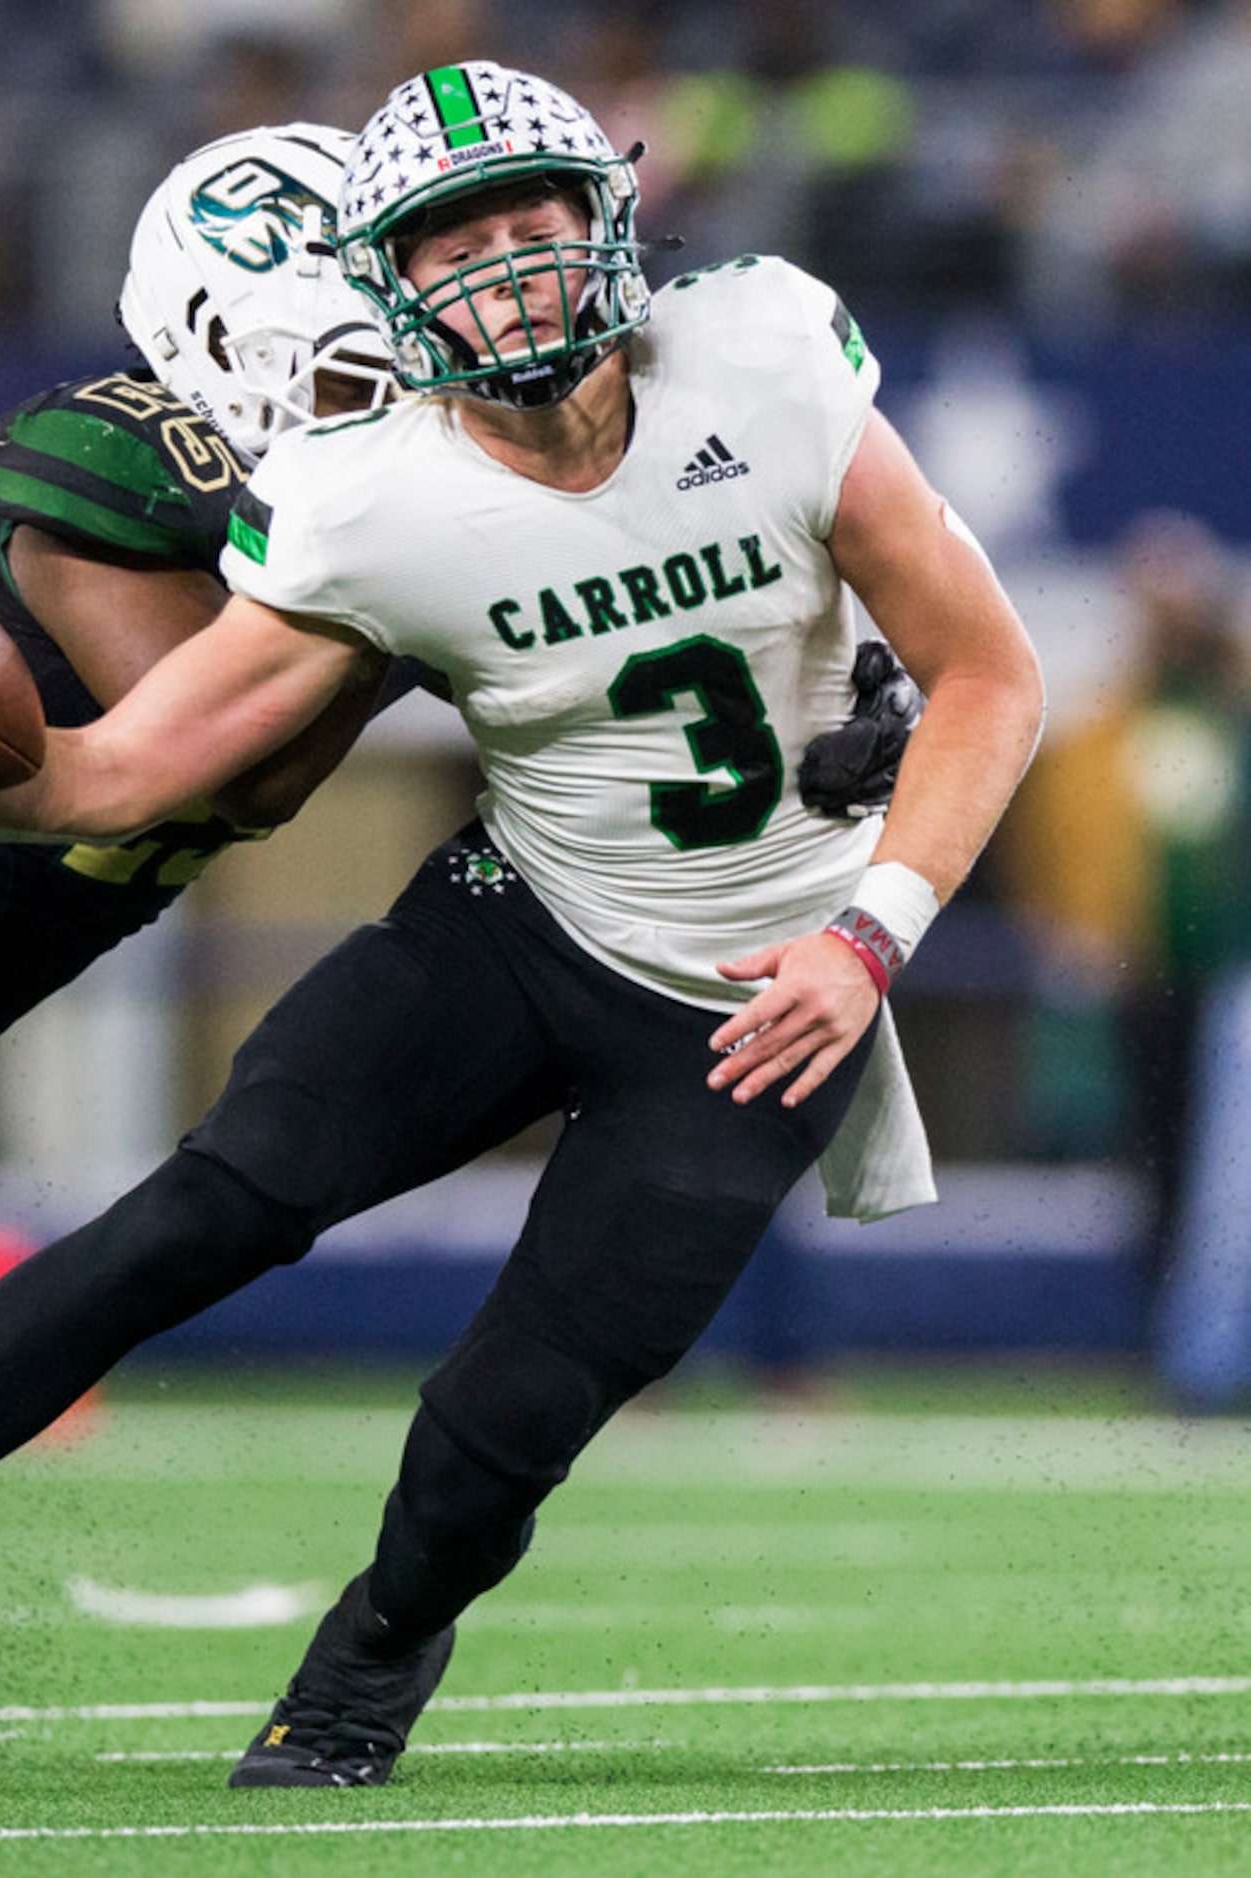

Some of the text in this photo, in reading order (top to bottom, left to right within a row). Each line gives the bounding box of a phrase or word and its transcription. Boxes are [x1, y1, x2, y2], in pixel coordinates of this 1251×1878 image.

[450, 141, 504, 166] DRAGONS
[676, 461, 750, 491] adidas
[487, 533, 782, 651] CARROLL
[606, 633, 785, 852] 3
